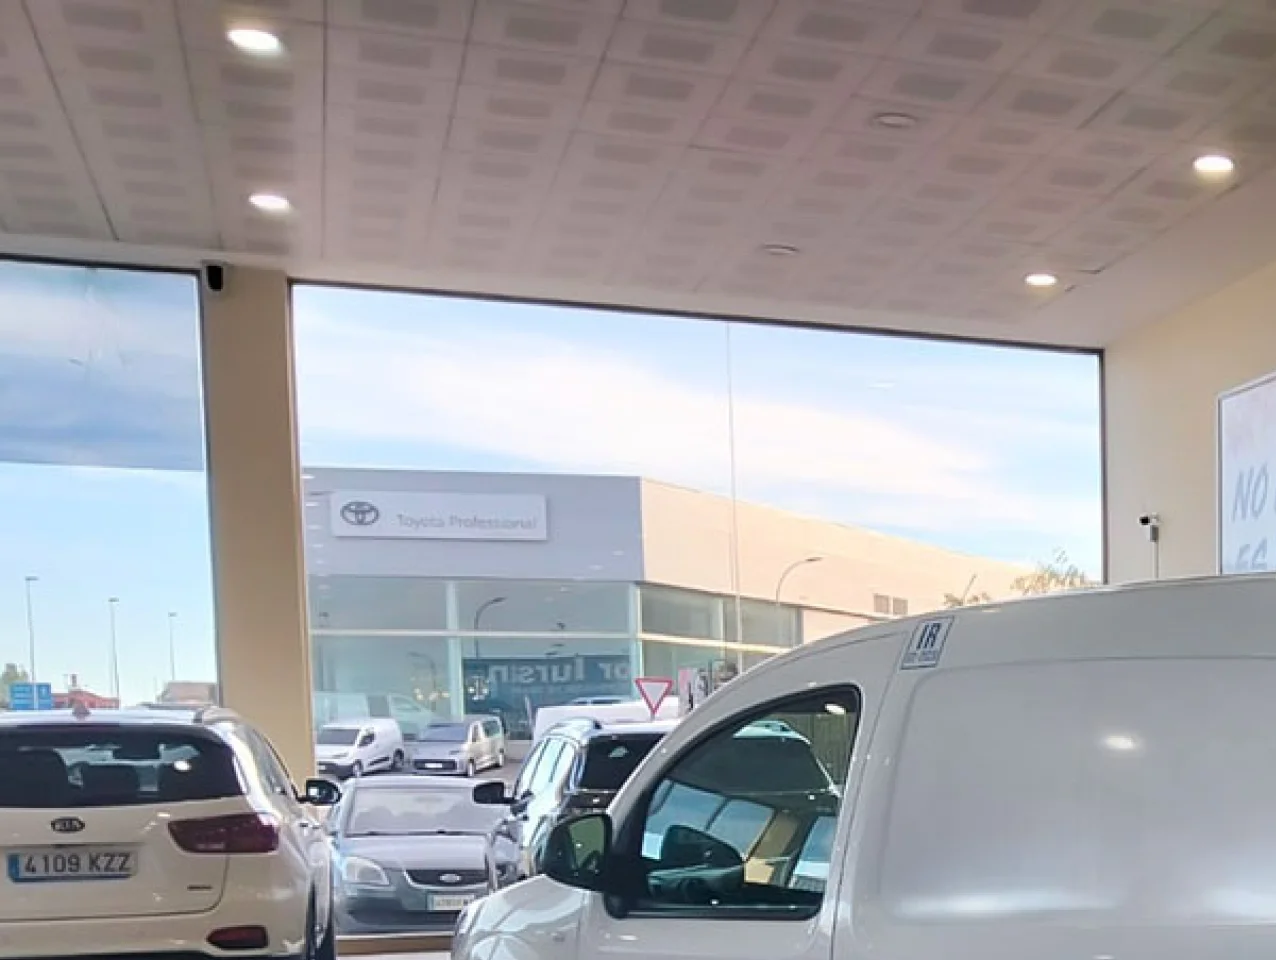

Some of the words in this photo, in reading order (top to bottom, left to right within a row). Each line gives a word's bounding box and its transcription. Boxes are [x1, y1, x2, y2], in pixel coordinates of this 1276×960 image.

[1231, 461, 1270, 523] NO
[396, 513, 445, 530] Toyota
[24, 853, 81, 874] 4109
[88, 852, 132, 873] KZZ
